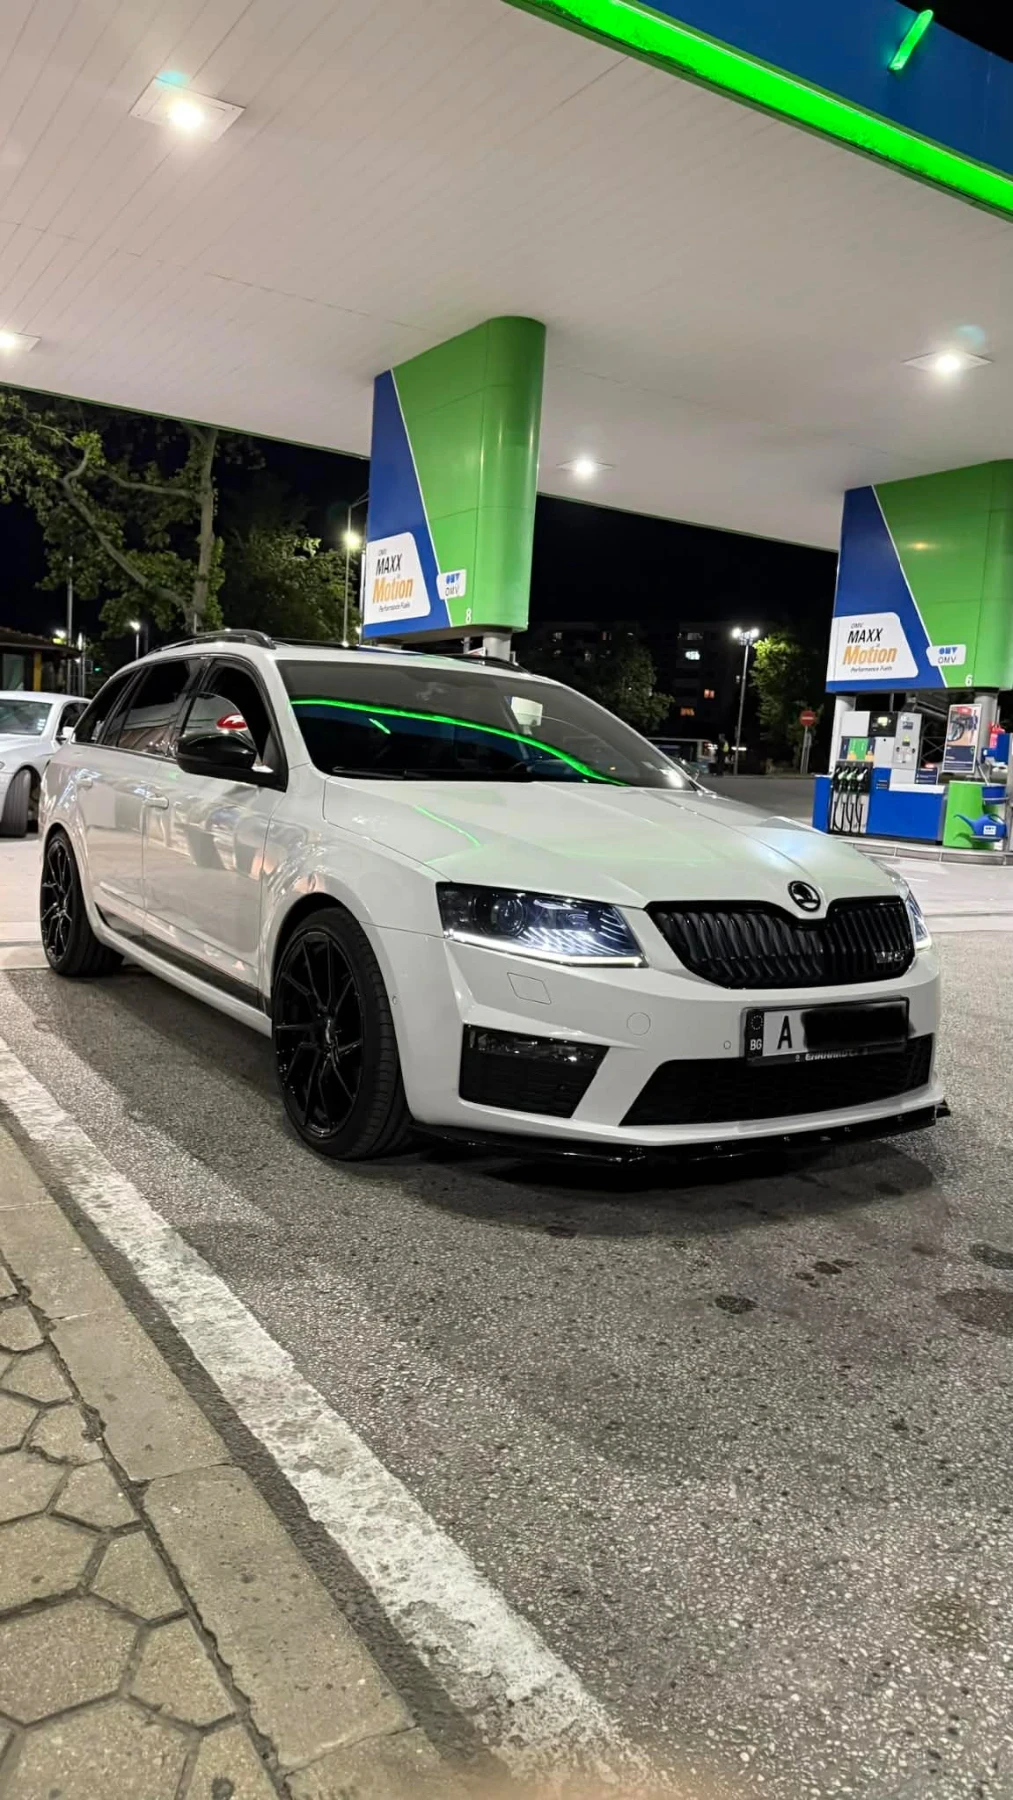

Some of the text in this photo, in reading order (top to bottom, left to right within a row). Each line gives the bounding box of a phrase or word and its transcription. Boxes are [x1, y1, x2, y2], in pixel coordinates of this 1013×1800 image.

[376, 553, 402, 576] MAXX
[373, 575, 413, 603] Motion
[445, 586, 459, 597] OMV
[466, 608, 472, 624] 8
[847, 628, 883, 643] MAXX
[842, 644, 897, 665] Motion
[938, 656, 956, 664] OMV
[965, 674, 973, 687] 6
[777, 1015, 792, 1049] A
[750, 1038, 762, 1050] BG
